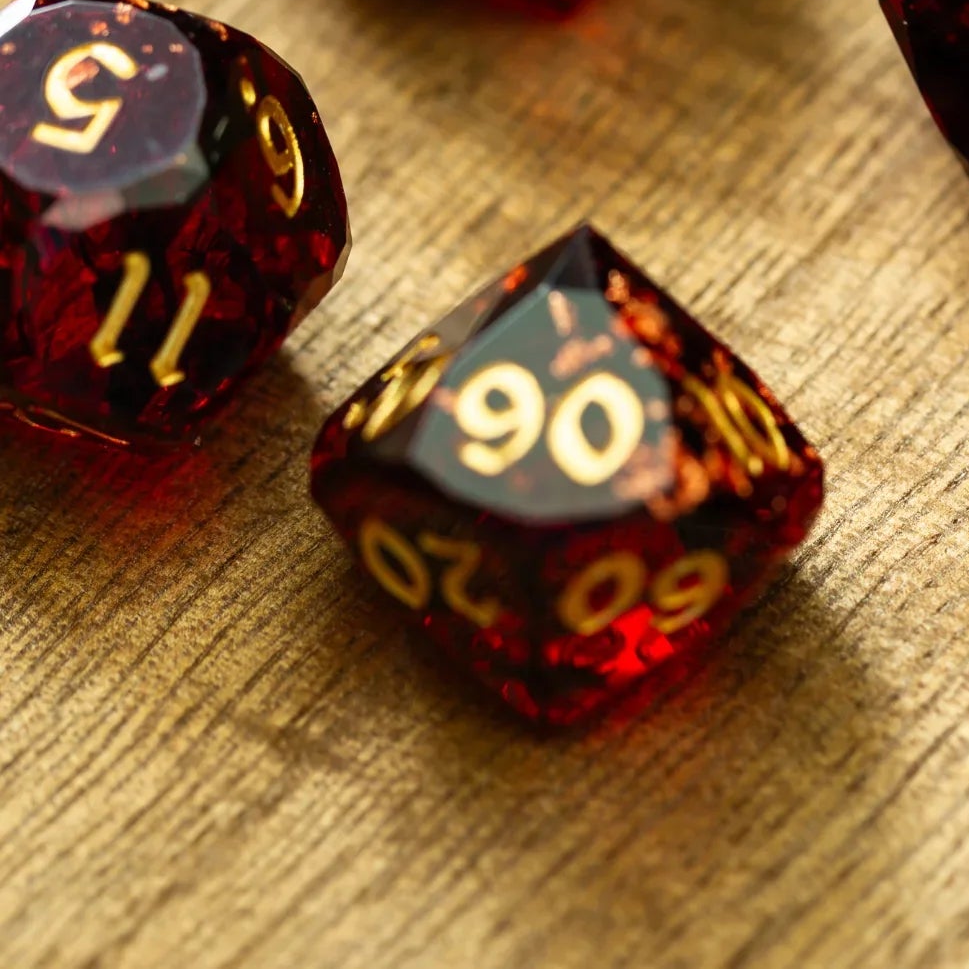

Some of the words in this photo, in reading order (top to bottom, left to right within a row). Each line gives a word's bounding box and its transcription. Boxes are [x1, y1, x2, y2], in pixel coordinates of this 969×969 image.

[31, 40, 140, 155] 5
[89, 249, 212, 388] 11
[454, 360, 646, 488] 90
